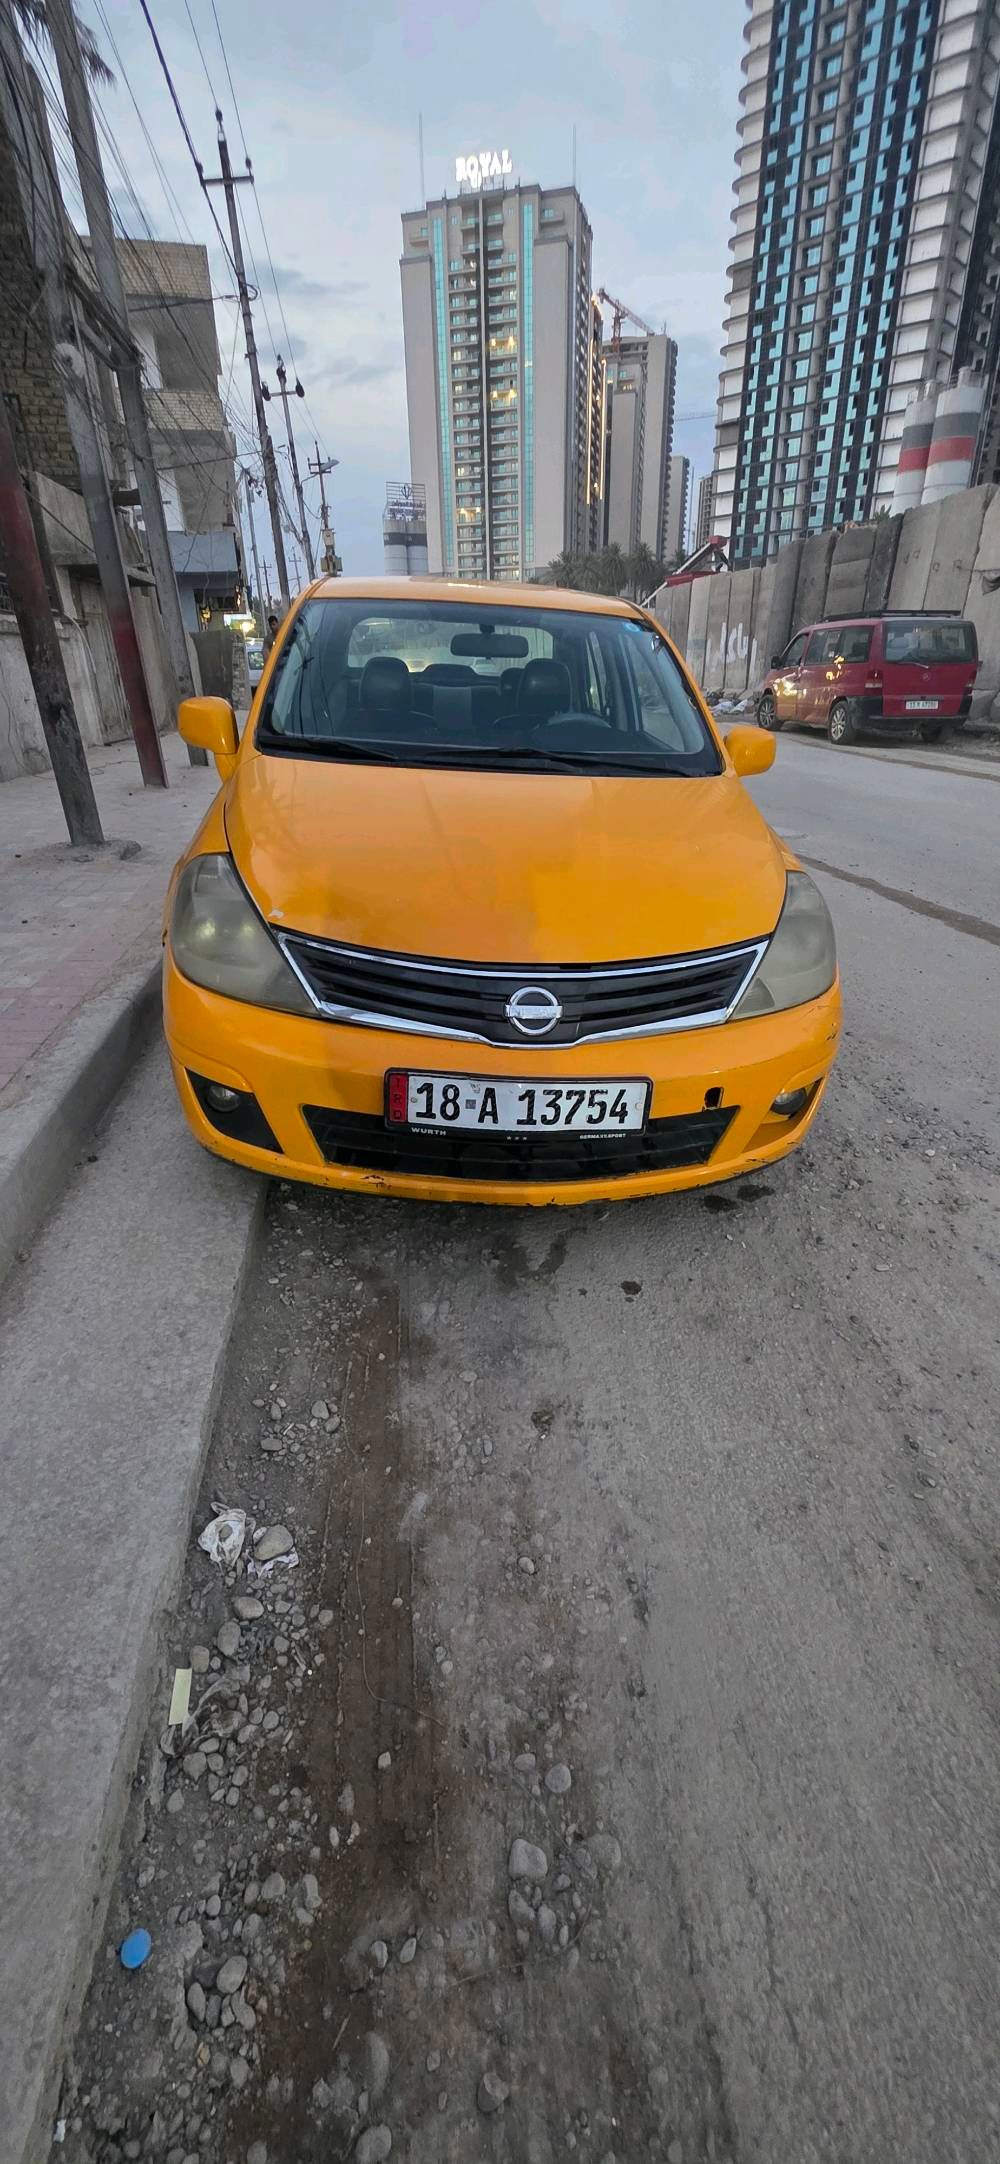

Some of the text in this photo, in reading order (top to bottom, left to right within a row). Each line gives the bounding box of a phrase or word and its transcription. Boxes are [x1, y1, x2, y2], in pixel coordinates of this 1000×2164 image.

[455, 149, 513, 183] ROYAL
[509, 1006, 558, 1018] NIAN
[416, 1082, 629, 1126] 18 A 13754
